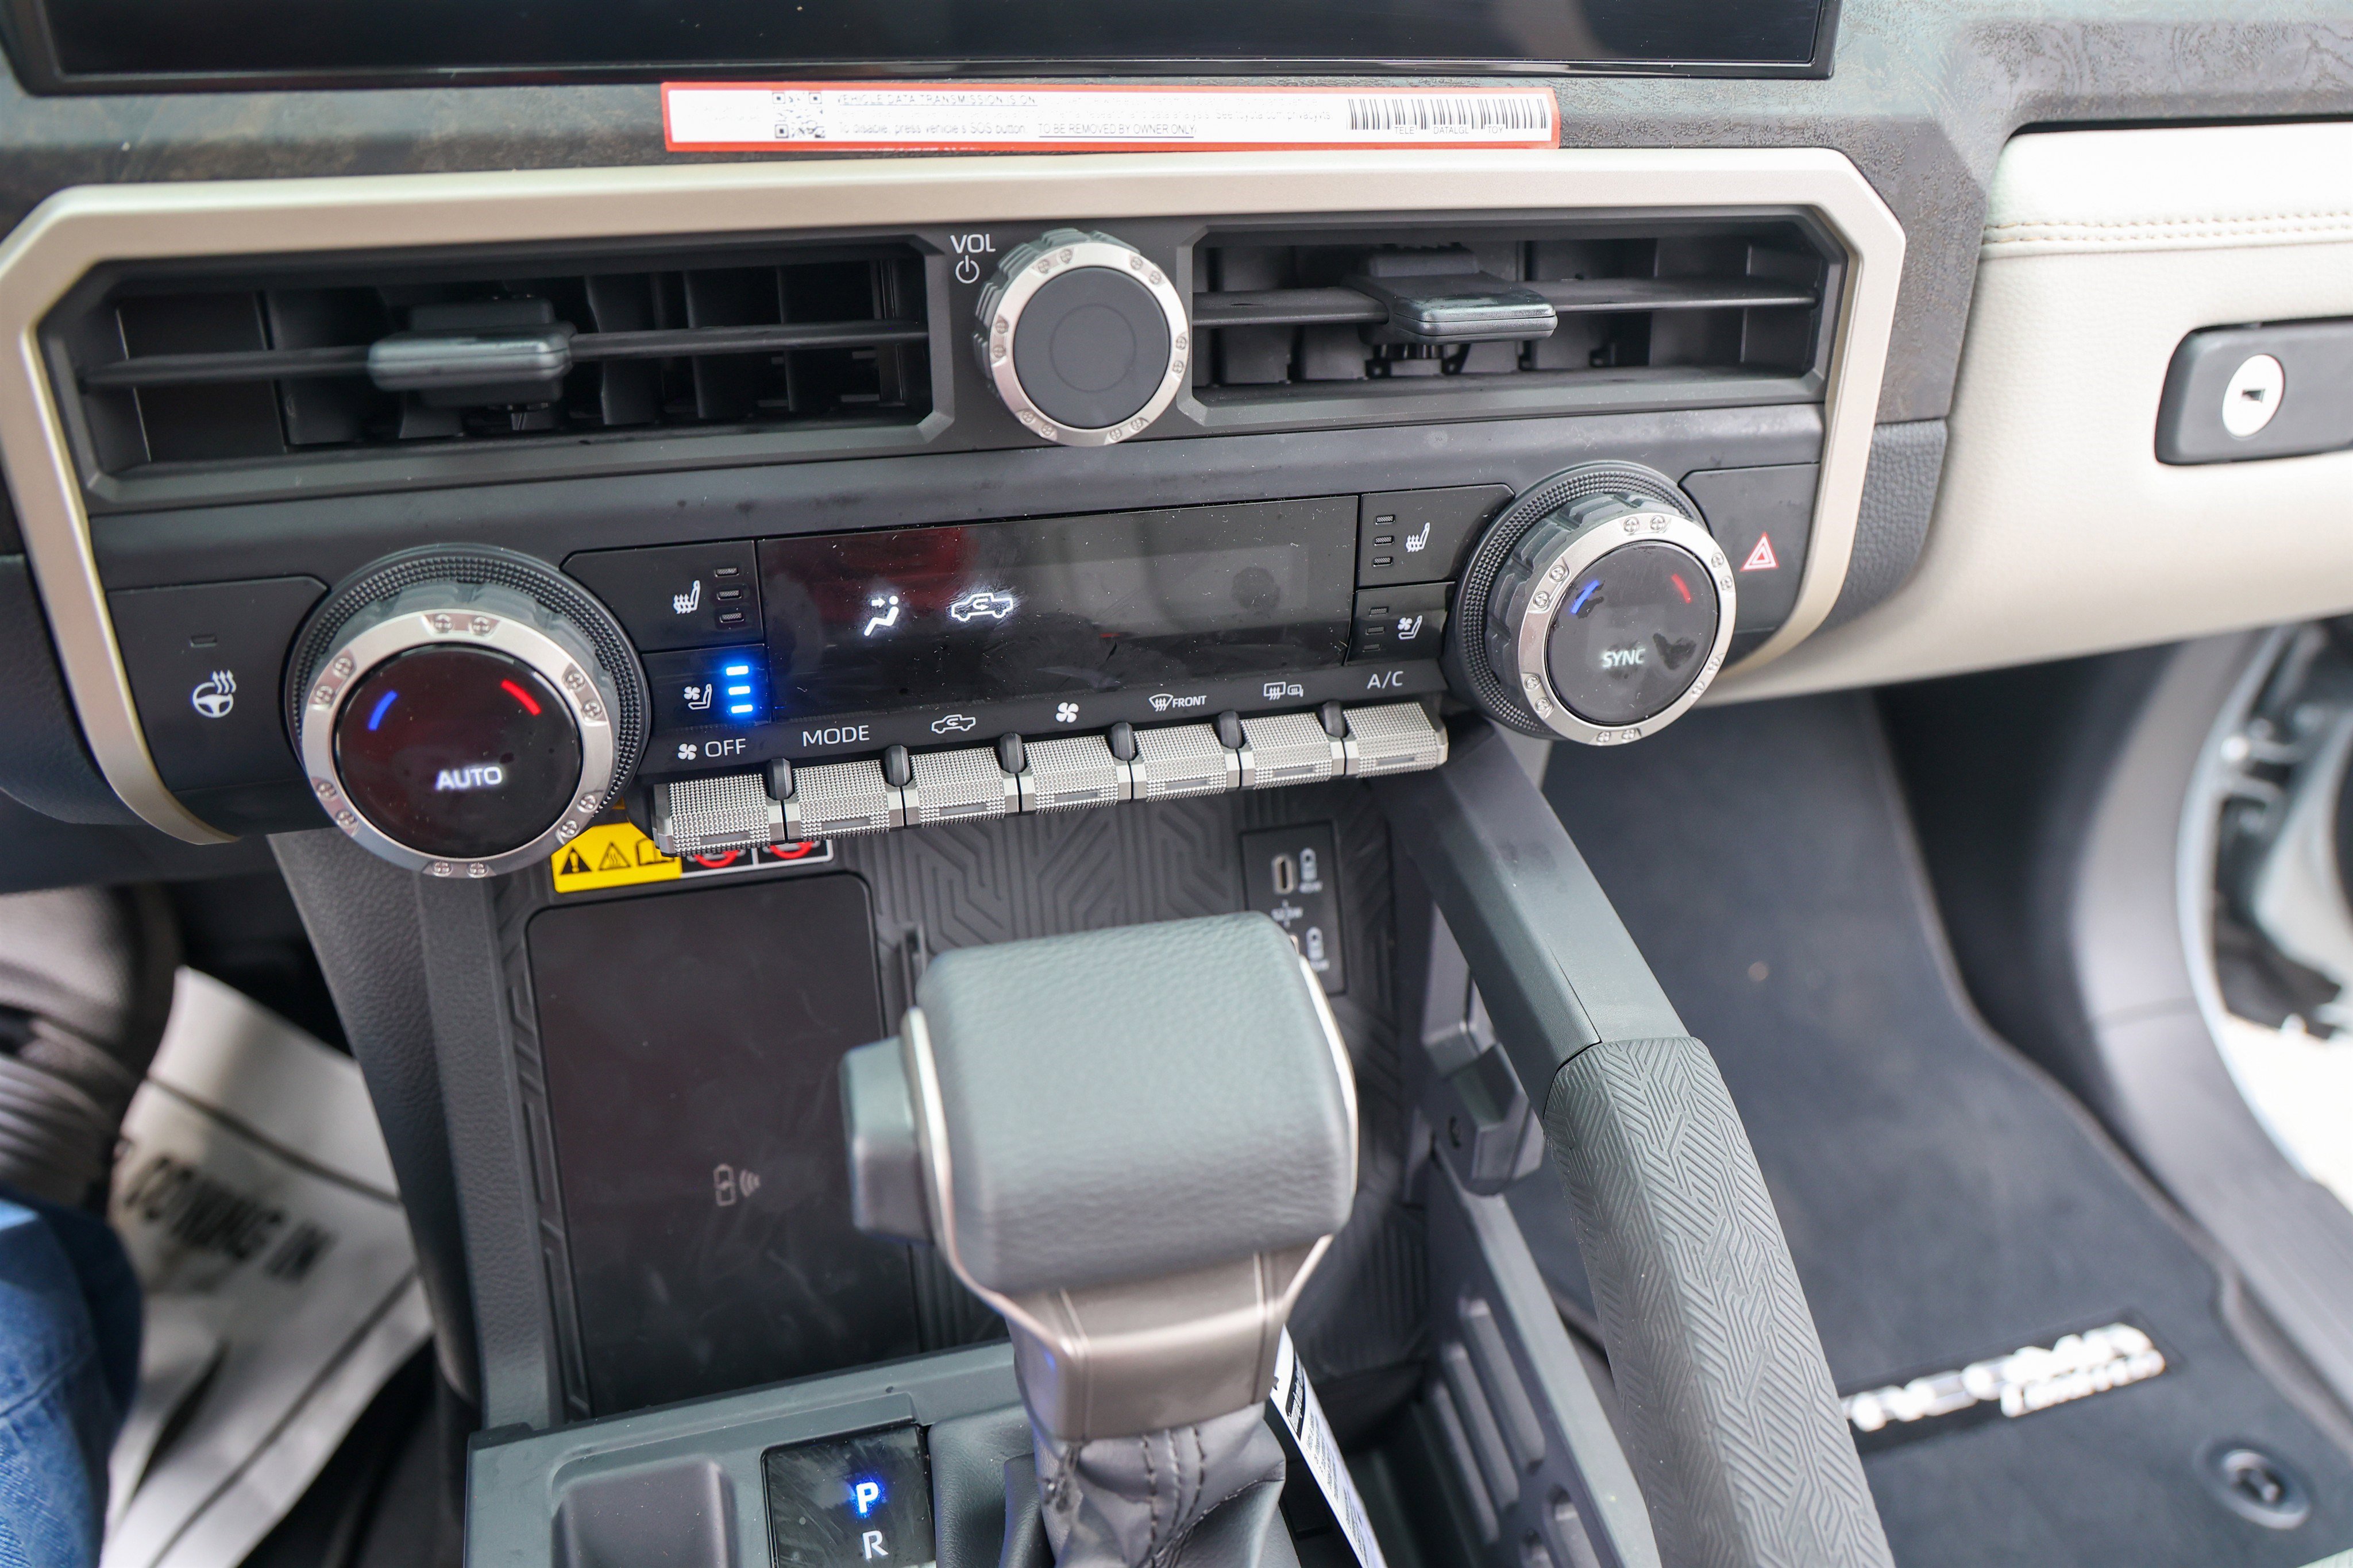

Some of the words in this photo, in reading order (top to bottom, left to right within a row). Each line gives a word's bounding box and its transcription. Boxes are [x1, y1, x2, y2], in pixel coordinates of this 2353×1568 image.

[888, 94, 915, 104] DATA
[970, 122, 992, 134] SOS
[1037, 123, 1051, 134] TO
[1054, 123, 1066, 134] BE
[1069, 123, 1117, 134] REMOVED
[1118, 123, 1131, 134] BY
[1133, 123, 1169, 134] OWNER
[1394, 126, 1415, 135] TELE
[1433, 126, 1469, 135] DATALGL
[1487, 126, 1503, 134] TOY
[949, 234, 996, 253] VOL
[1601, 647, 1646, 669] SYNC
[1367, 670, 1404, 690] A/C
[1172, 694, 1207, 709] FRONT
[802, 724, 870, 747] MODE
[704, 738, 746, 758] OFF
[435, 766, 503, 791] AUTO
[855, 1482, 880, 1513] P
[862, 1530, 889, 1560] R
